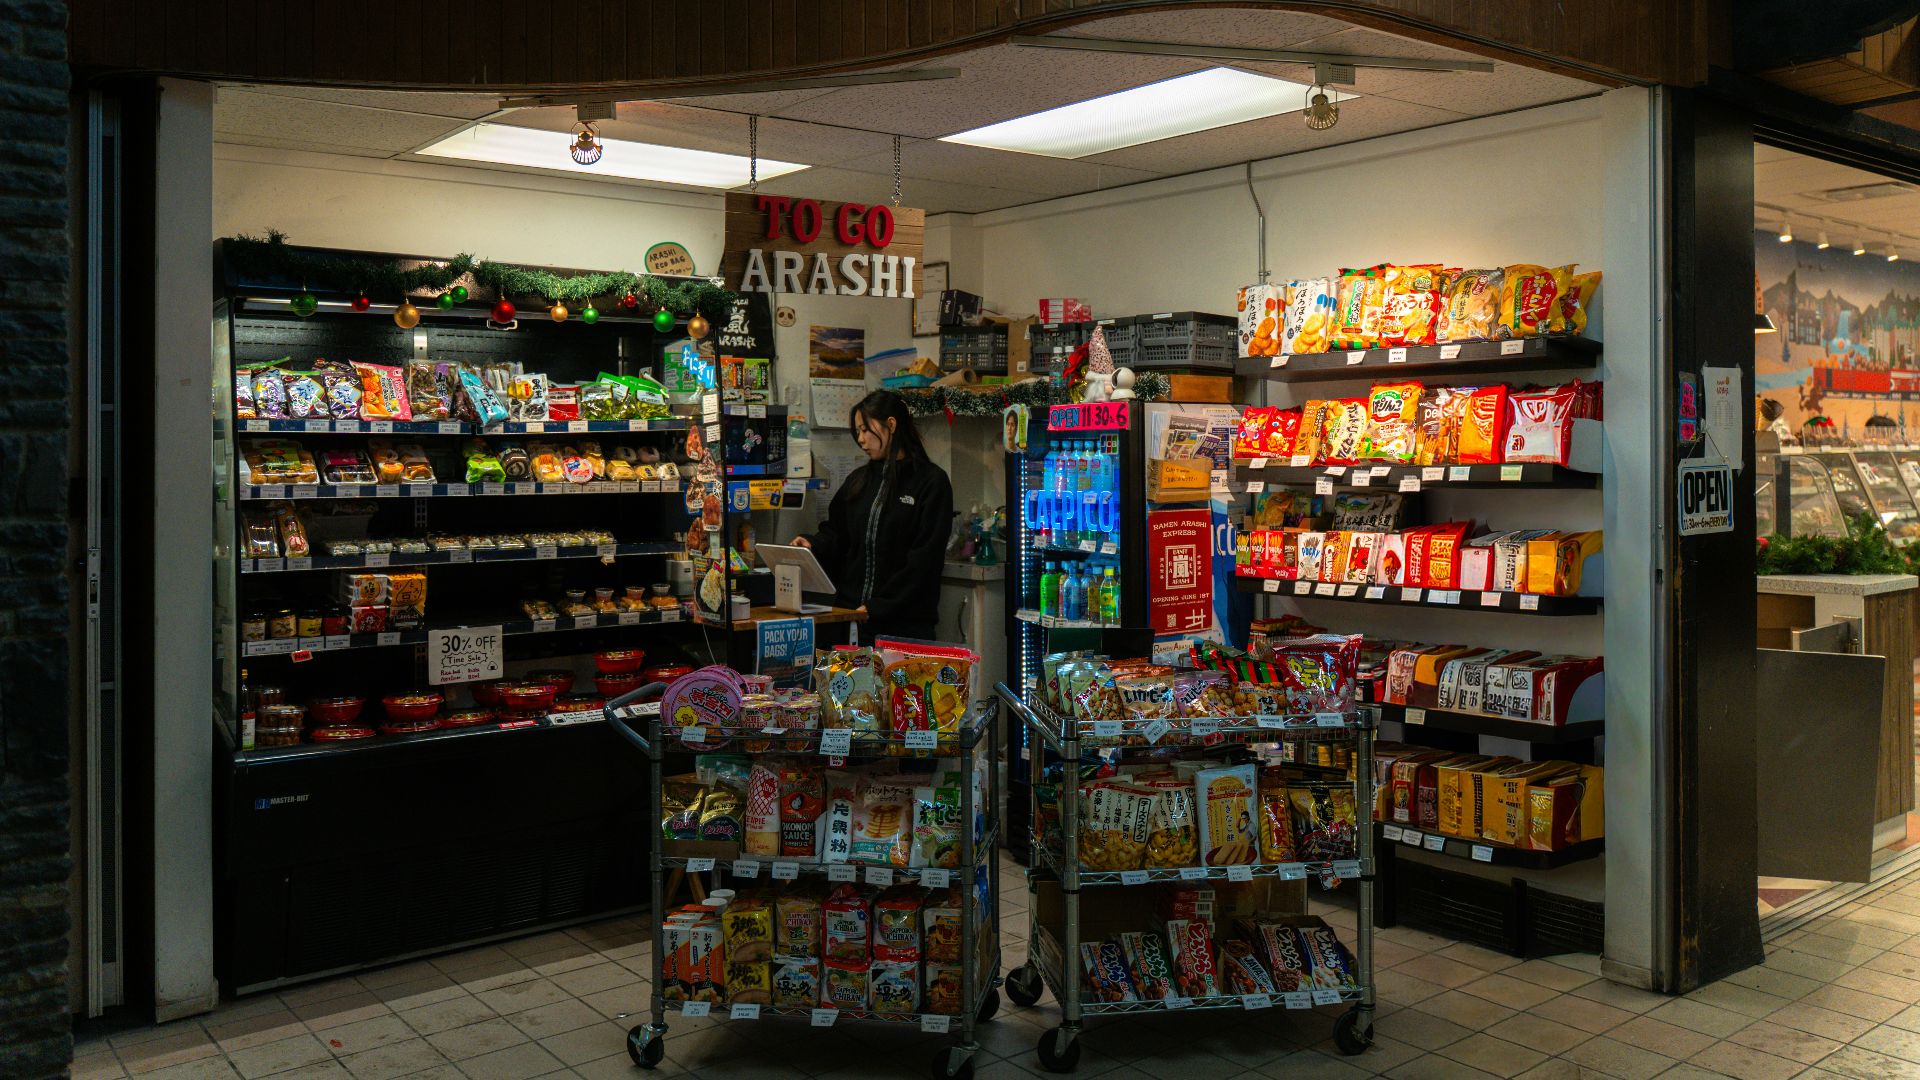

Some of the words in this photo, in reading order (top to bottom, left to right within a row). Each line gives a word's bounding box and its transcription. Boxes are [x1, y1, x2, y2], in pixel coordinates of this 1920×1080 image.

[758, 195, 822, 243] TO
[838, 202, 895, 248] GO
[649, 249, 677, 262] ARASHI
[655, 261, 668, 270] ECO
[740, 248, 916, 299] ARASHI
[1050, 407, 1080, 428] OPEN
[1683, 470, 1729, 515] OPEN
[1025, 490, 1114, 532] CALPICO
[1153, 521, 1178, 531] RAMEN
[1180, 519, 1207, 528] ARASHI
[1162, 529, 1197, 538] EXPRESS
[1181, 592, 1197, 600] JUNE
[764, 629, 785, 643] PACK
[786, 627, 808, 642] YOUR
[441, 635, 472, 654] 30%
[476, 635, 499, 651] OFF
[764, 643, 788, 659] BAGS!
[447, 656, 464, 665] Time
[468, 654, 482, 662] Sale
[831, 803, 850, 854] 片栗粉
[784, 832, 810, 843] SAUCE
